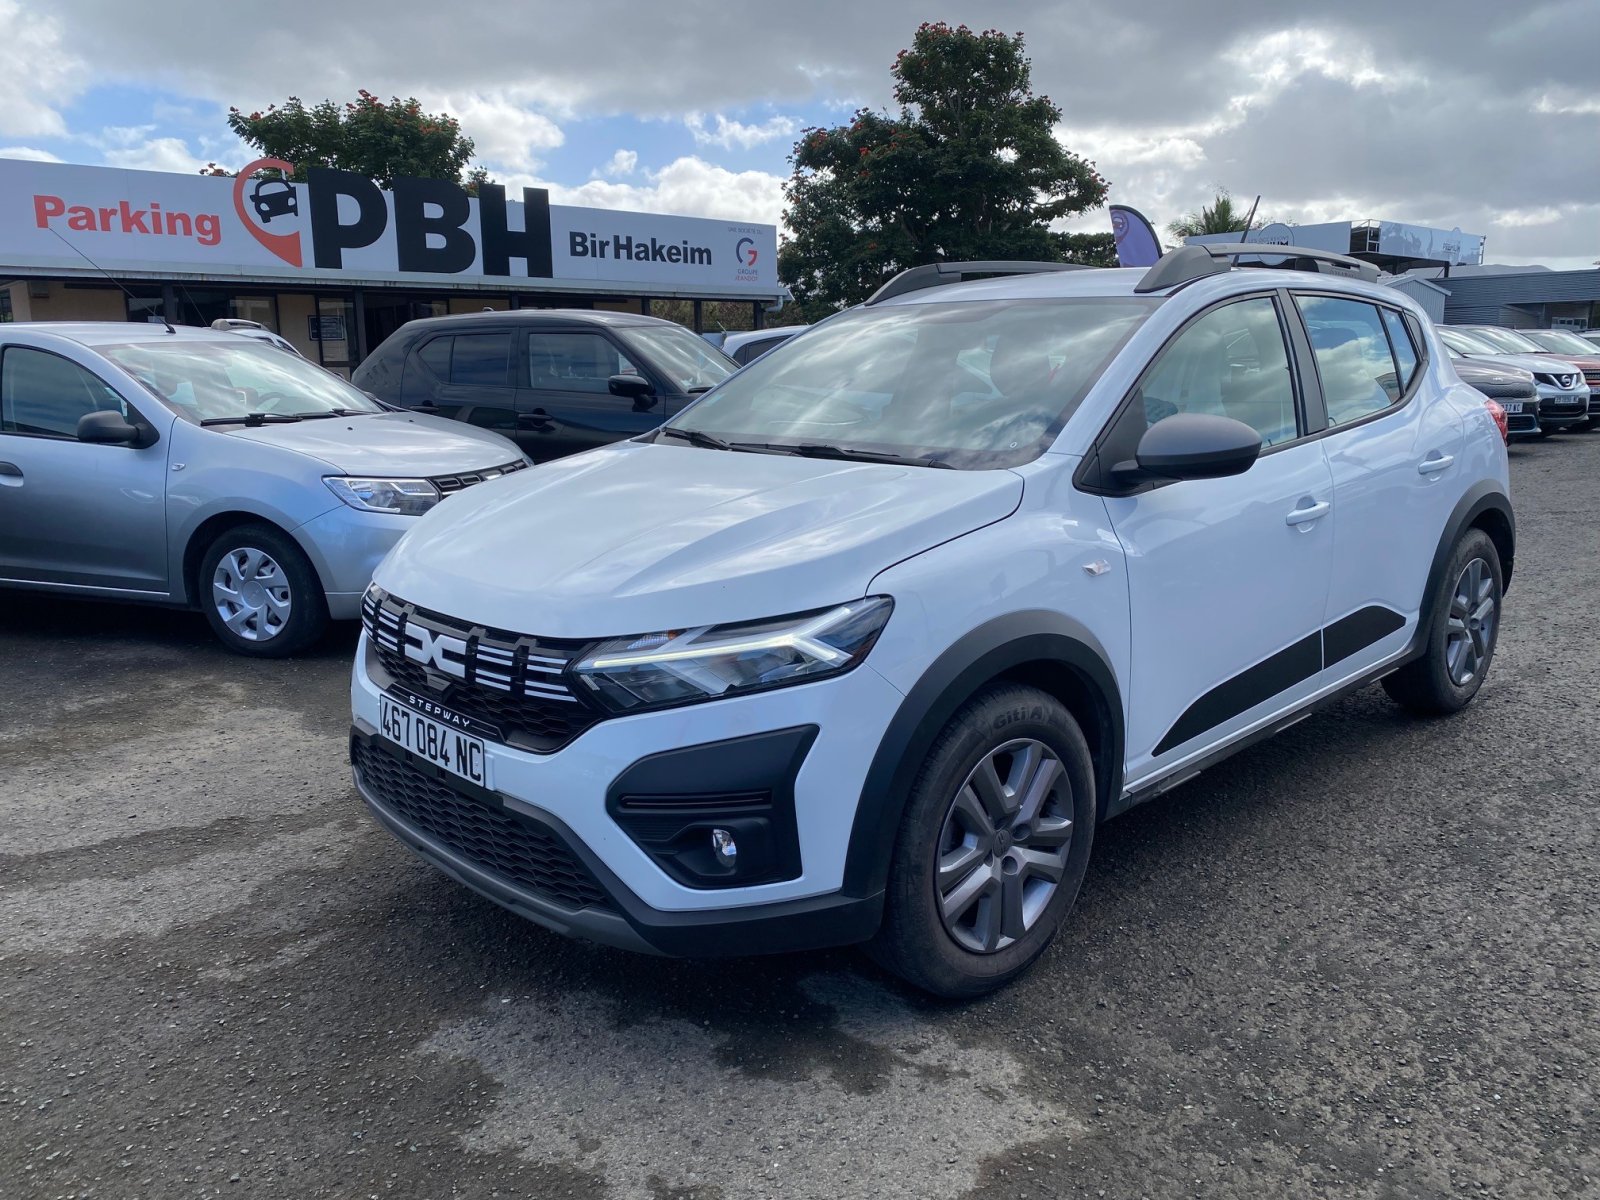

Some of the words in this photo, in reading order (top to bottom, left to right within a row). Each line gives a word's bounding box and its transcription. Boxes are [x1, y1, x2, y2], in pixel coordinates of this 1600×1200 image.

[34, 195, 222, 246] Parking
[307, 167, 553, 279] PBH
[382, 701, 411, 747] 467
[416, 717, 450, 767] 084
[456, 735, 482, 782] NC
[409, 695, 471, 727] STEPWAY
